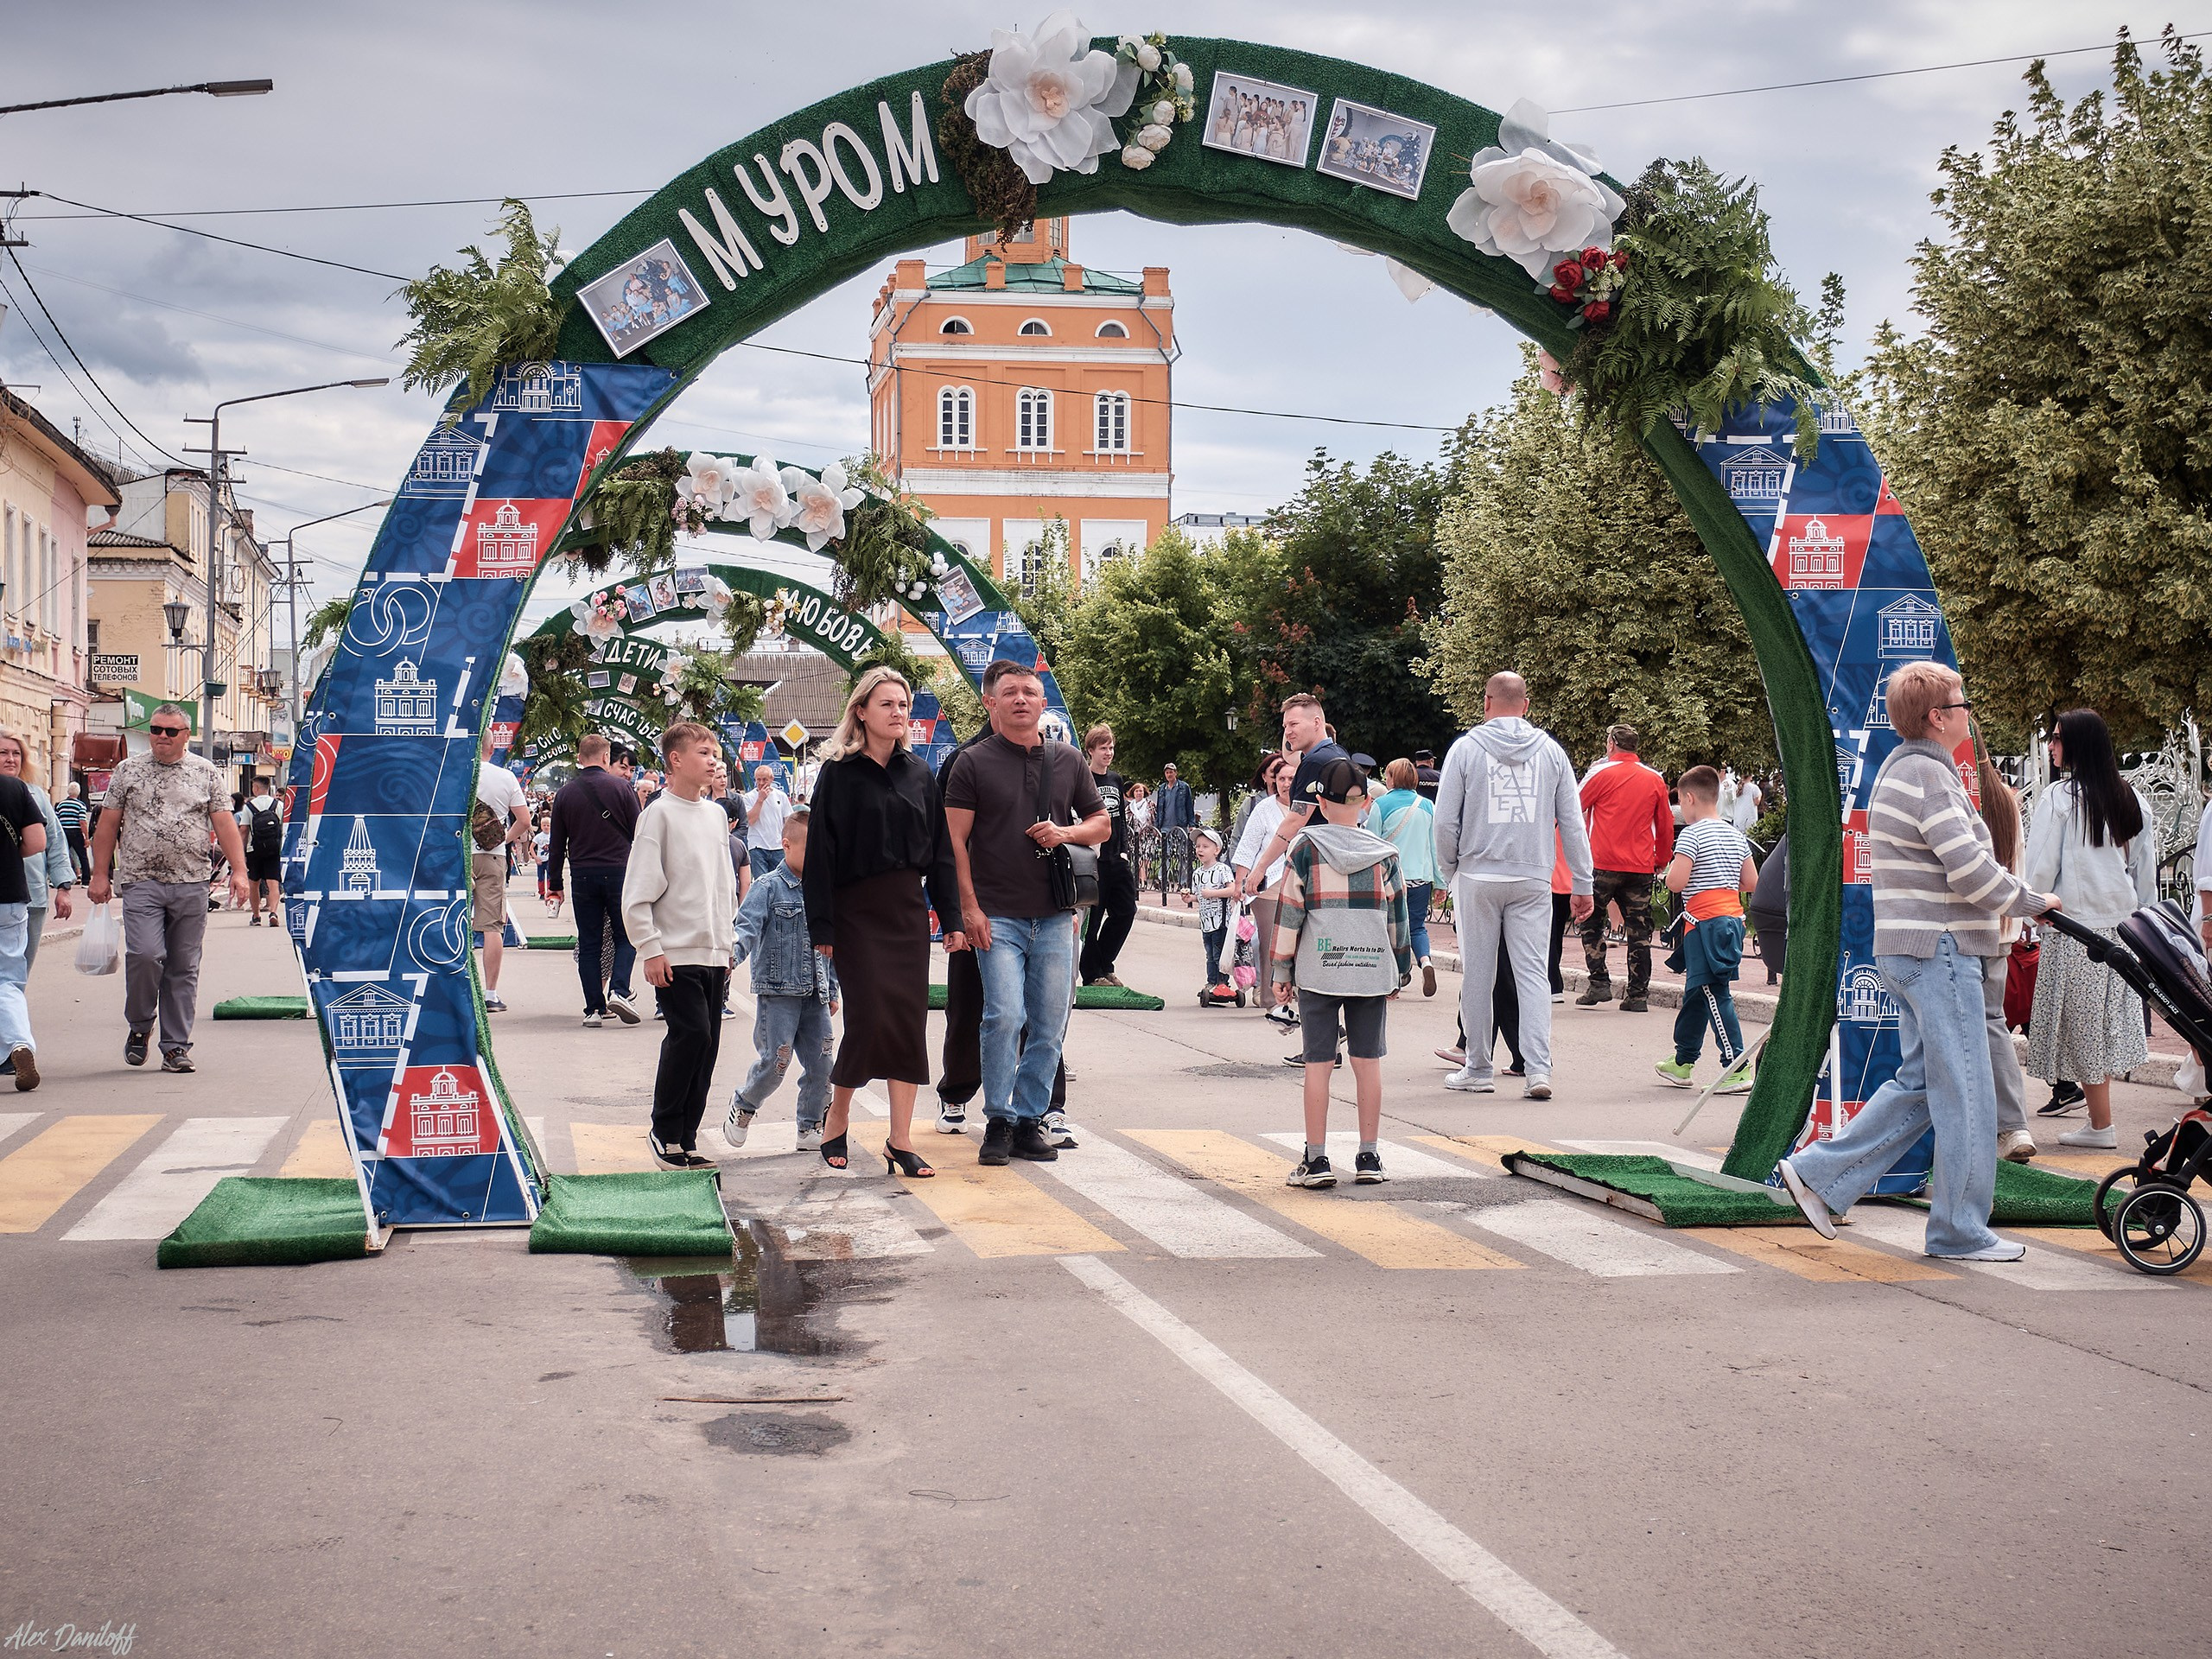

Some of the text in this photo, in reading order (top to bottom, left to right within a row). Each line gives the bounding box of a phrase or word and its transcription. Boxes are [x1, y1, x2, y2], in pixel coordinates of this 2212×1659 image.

[678, 91, 939, 291] МУРОМ
[93, 656, 137, 664] РЕМОНТ
[605, 639, 661, 671] ДЕТИ
[1317, 938, 1332, 951] BE
